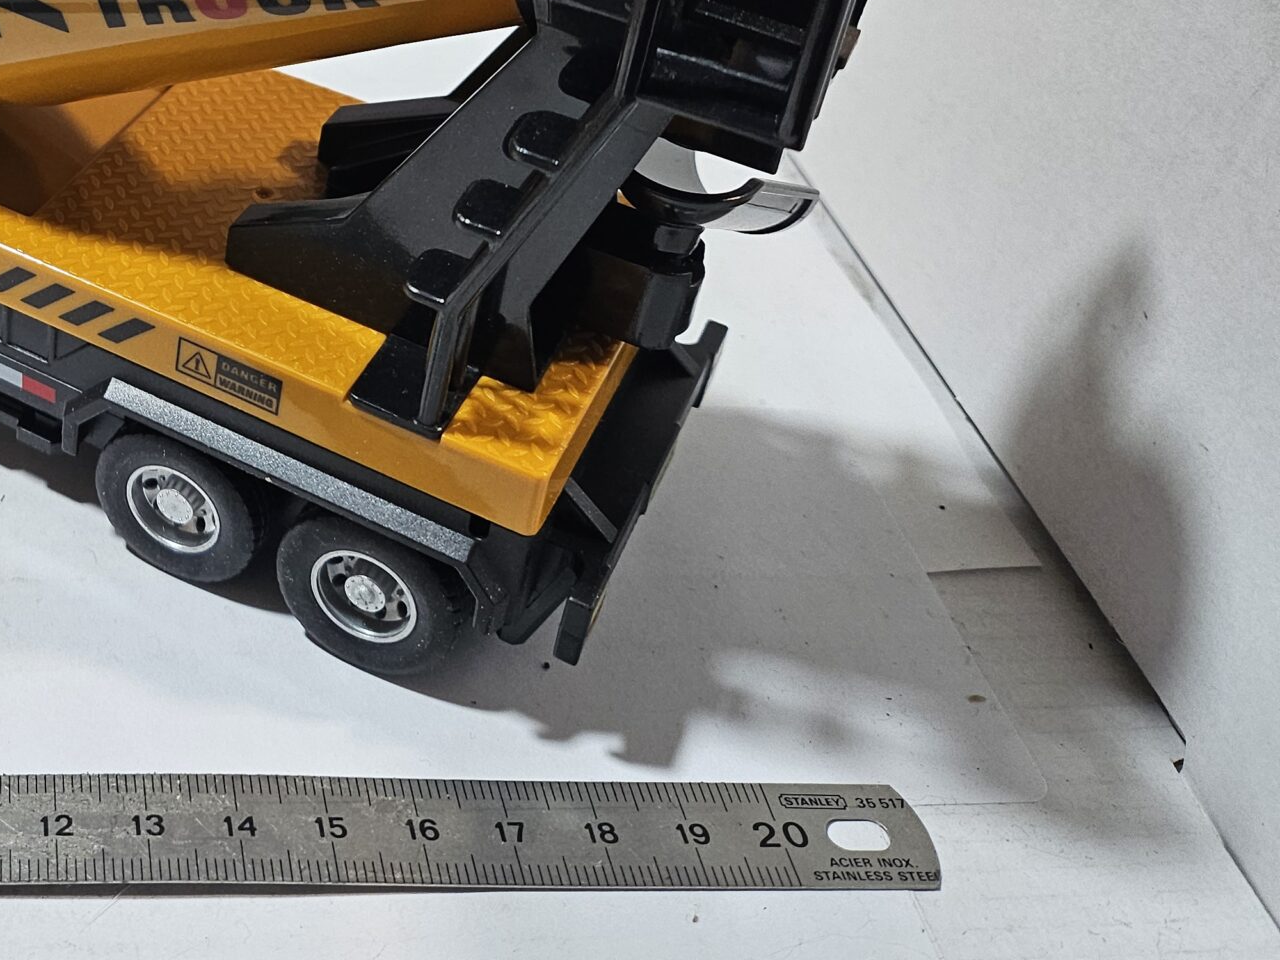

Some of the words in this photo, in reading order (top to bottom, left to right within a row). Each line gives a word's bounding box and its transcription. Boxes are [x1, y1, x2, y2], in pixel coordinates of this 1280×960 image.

[220, 360, 278, 393] DANGER
[218, 374, 275, 410] WARNING
[783, 796, 841, 807] STANLEY
[40, 814, 74, 837] 12
[131, 814, 165, 836] 13
[223, 815, 257, 837] 14
[314, 816, 348, 839] 15
[405, 818, 440, 841] 16
[494, 821, 524, 843] 17
[584, 822, 619, 844] 18
[675, 823, 711, 845] 19
[752, 821, 809, 848] 20
[830, 857, 872, 868] ACIER
[814, 871, 893, 882] STAINLESS
